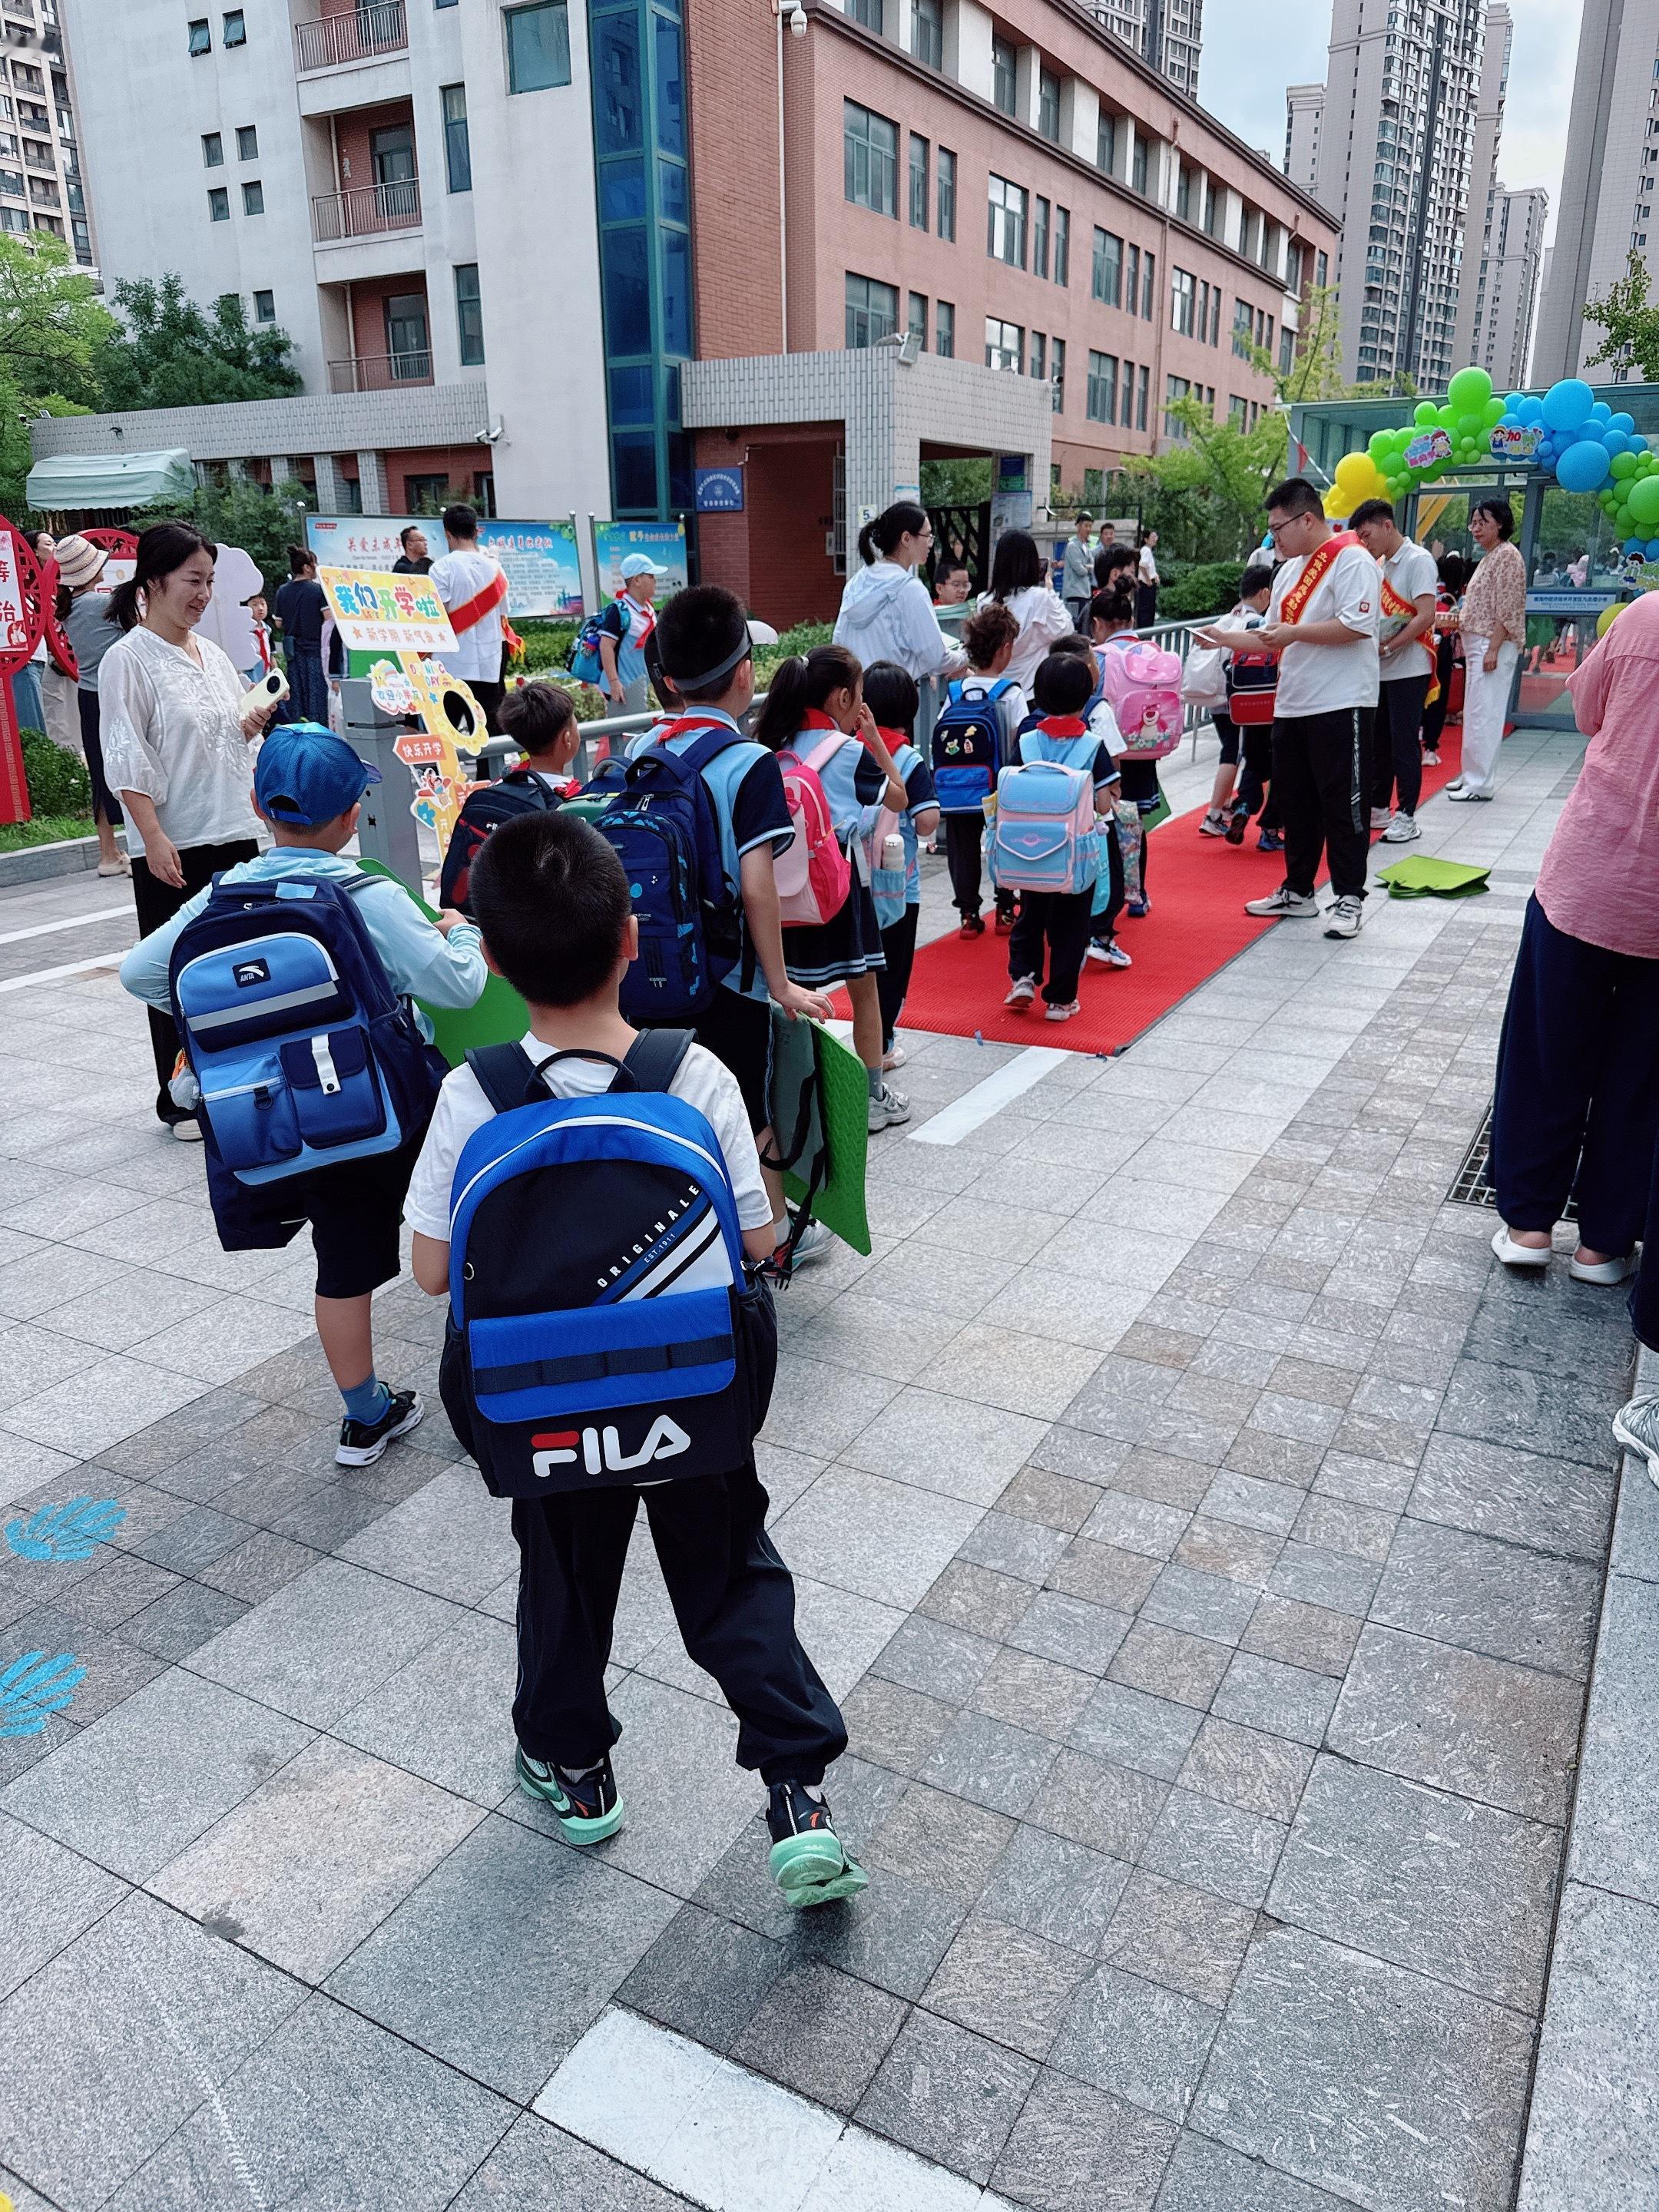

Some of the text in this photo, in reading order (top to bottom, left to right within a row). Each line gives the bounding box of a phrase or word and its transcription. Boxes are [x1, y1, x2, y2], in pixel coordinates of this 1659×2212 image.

[863, 509, 870, 520] 5
[335, 581, 440, 619] 我们开学啦
[366, 627, 435, 644] 新学期 新气象
[402, 741, 442, 758] 快乐开学
[240, 972, 255, 982] ANTA
[597, 1185, 699, 1287] ORIGINALE
[644, 1233, 676, 1263] EST.1911
[531, 1414, 691, 1477] FILA
